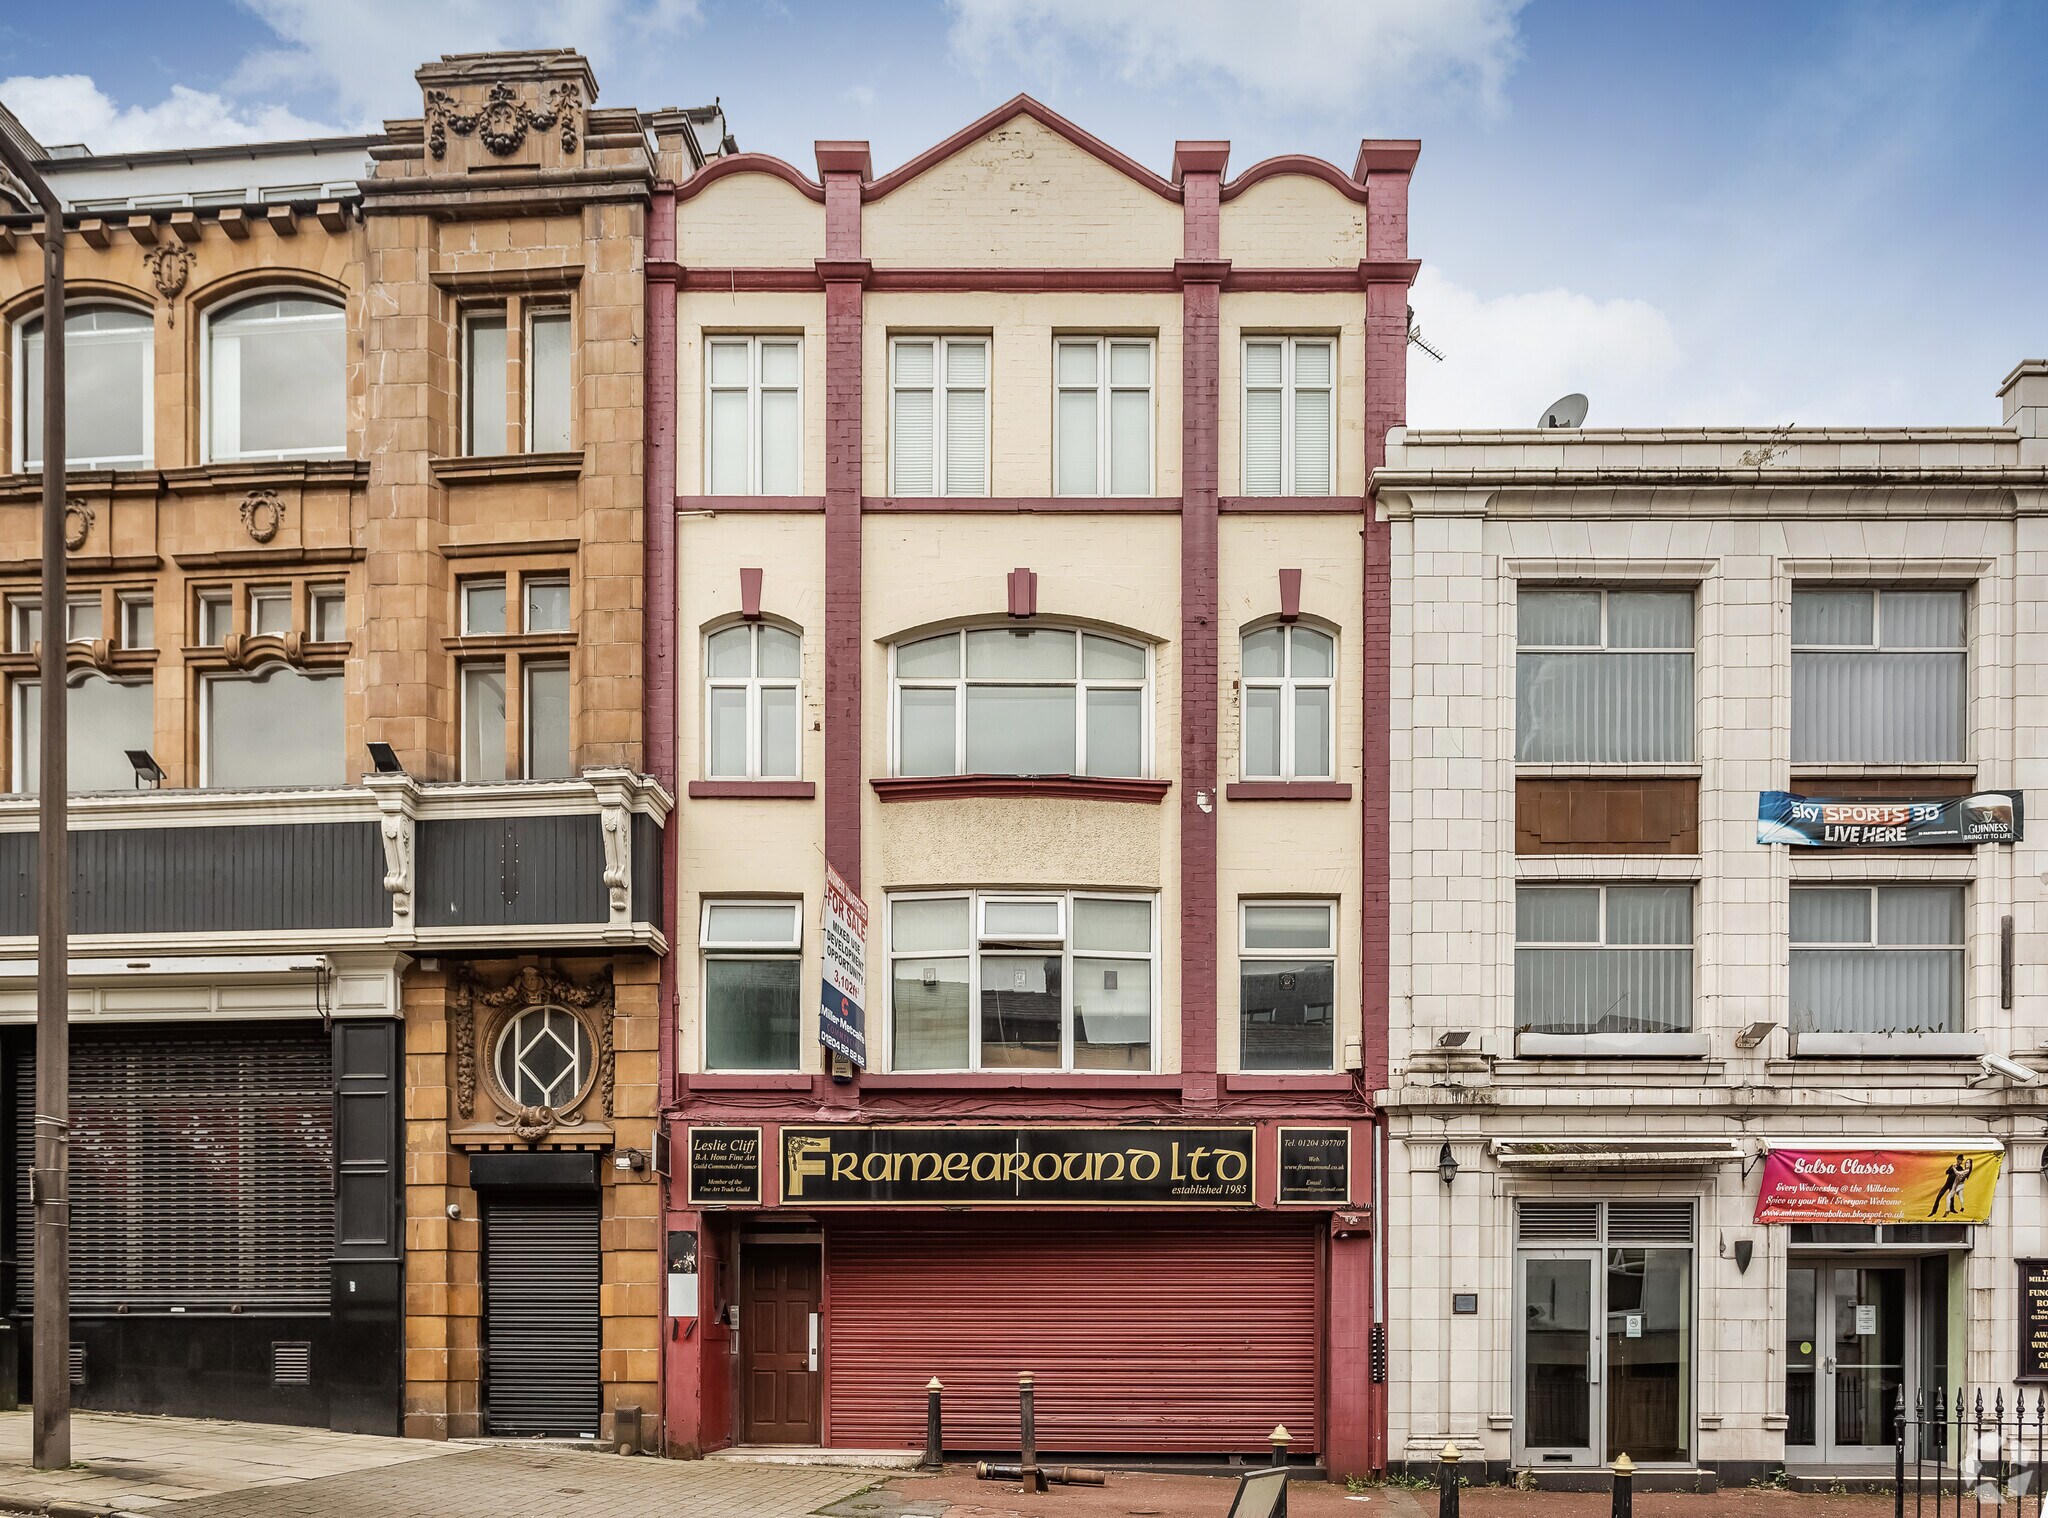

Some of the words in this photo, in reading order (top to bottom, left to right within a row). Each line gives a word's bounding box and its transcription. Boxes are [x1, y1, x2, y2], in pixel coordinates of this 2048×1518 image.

[1792, 802, 1819, 822] sky
[1825, 807, 1904, 822] SPORTS
[1913, 807, 1939, 822] 3D
[1825, 825, 1859, 842] LIVE
[1862, 826, 1907, 842] HERE
[1969, 823, 2008, 834] GUINNESS
[828, 887, 844, 921] FOR
[847, 907, 865, 943] SALE
[833, 920, 850, 943] MIXED
[851, 937, 861, 955] USE
[827, 929, 864, 972] DEVELOPMENT
[827, 945, 864, 985] OPPORTUNITY
[821, 1004, 839, 1025] Miller
[840, 1017, 865, 1044] Metcalfe
[821, 1030, 840, 1050] 01204
[841, 1044, 849, 1056] 52
[850, 1049, 857, 1061] 52
[858, 1055, 865, 1067] 52
[693, 1139, 727, 1151] Leslie
[730, 1139, 757, 1153] Cliff
[1284, 1139, 1296, 1147] Tel.
[1298, 1139, 1319, 1147] 01204
[1320, 1139, 1346, 1147] 397707
[695, 1153, 708, 1161] B.A.
[710, 1153, 727, 1161] Hons
[728, 1153, 744, 1161] Fine
[745, 1153, 756, 1161] Art
[1794, 1157, 1838, 1174] Salsa
[1840, 1157, 1895, 1175] Classes
[1171, 1184, 1223, 1195] established
[1225, 1185, 1247, 1194] 1985
[1776, 1182, 1798, 1194] Every
[1799, 1183, 1839, 1194] Wednesday
[1840, 1184, 1848, 1192] @
[1850, 1182, 1863, 1192] the
[1863, 1183, 1900, 1193] Millstone
[1766, 1196, 1786, 1206] Spice
[1787, 1197, 1797, 1206] up
[1798, 1198, 1816, 1206] your
[1817, 1196, 1829, 1205] life
[1834, 1196, 1869, 1207] Everyone
[1870, 1197, 1901, 1206] Welcome
